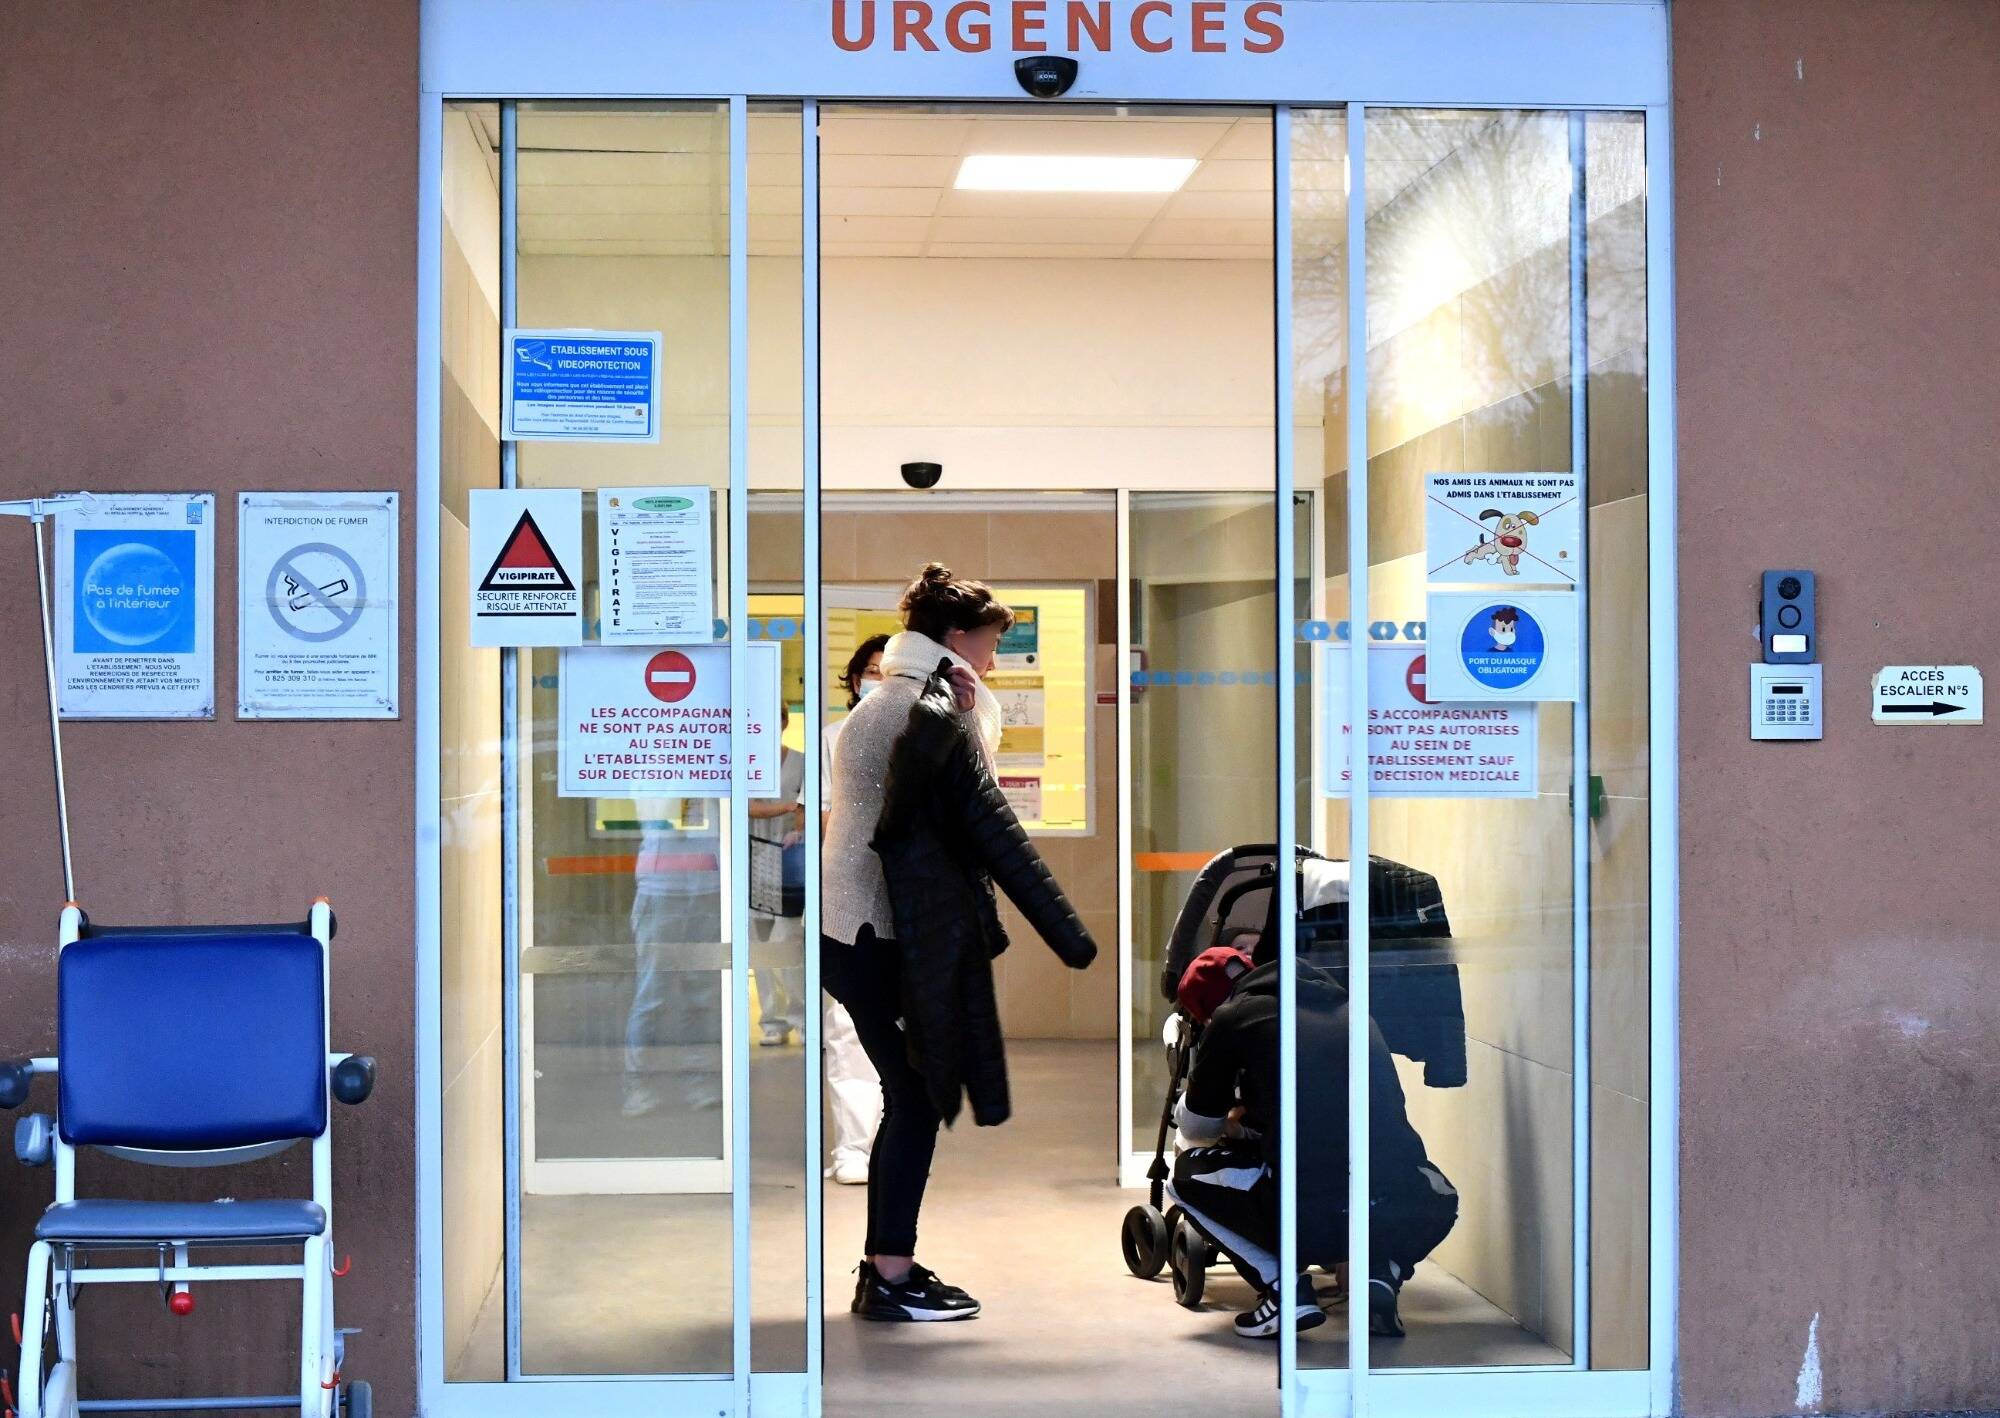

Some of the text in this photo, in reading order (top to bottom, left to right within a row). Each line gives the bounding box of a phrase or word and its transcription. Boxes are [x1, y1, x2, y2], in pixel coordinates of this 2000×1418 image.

[832, 0, 1285, 53] URGENCES
[551, 345, 648, 356] ETABLISSEMENT SOUS
[558, 360, 640, 370] VIDEOPROTECTION
[264, 517, 368, 525] INTERDICTION DE FUMER
[498, 572, 555, 580] VIGIPIRATE
[611, 529, 620, 626] VIGIPIRATE
[87, 584, 180, 597] Pas de fumée
[477, 592, 577, 601] SECURITE RENFORCEE
[487, 602, 568, 612] RISQUE ATTENTAT
[1503, 658, 1537, 666] MASQUE
[1900, 671, 1945, 681] ACCES
[1880, 685, 1969, 696] ESCALIER N°5
[591, 708, 616, 718] LES
[1383, 709, 1508, 720] ACCOMPAGNANTS
[579, 723, 598, 733] NE
[603, 723, 641, 734] SONT
[647, 723, 674, 734] PAS
[1408, 725, 1434, 735] PAS
[1439, 725, 1519, 735] AUTORISES
[629, 739, 711, 749] AU SEIN DE
[1390, 740, 1471, 750] AU SEIN DE
[585, 754, 715, 765] L'ETABLISSEMENT
[1479, 755, 1514, 766] SAUF
[578, 769, 607, 780] SUR
[612, 769, 684, 780] DECISION
[1374, 770, 1519, 781] DECISION MEDICALE
